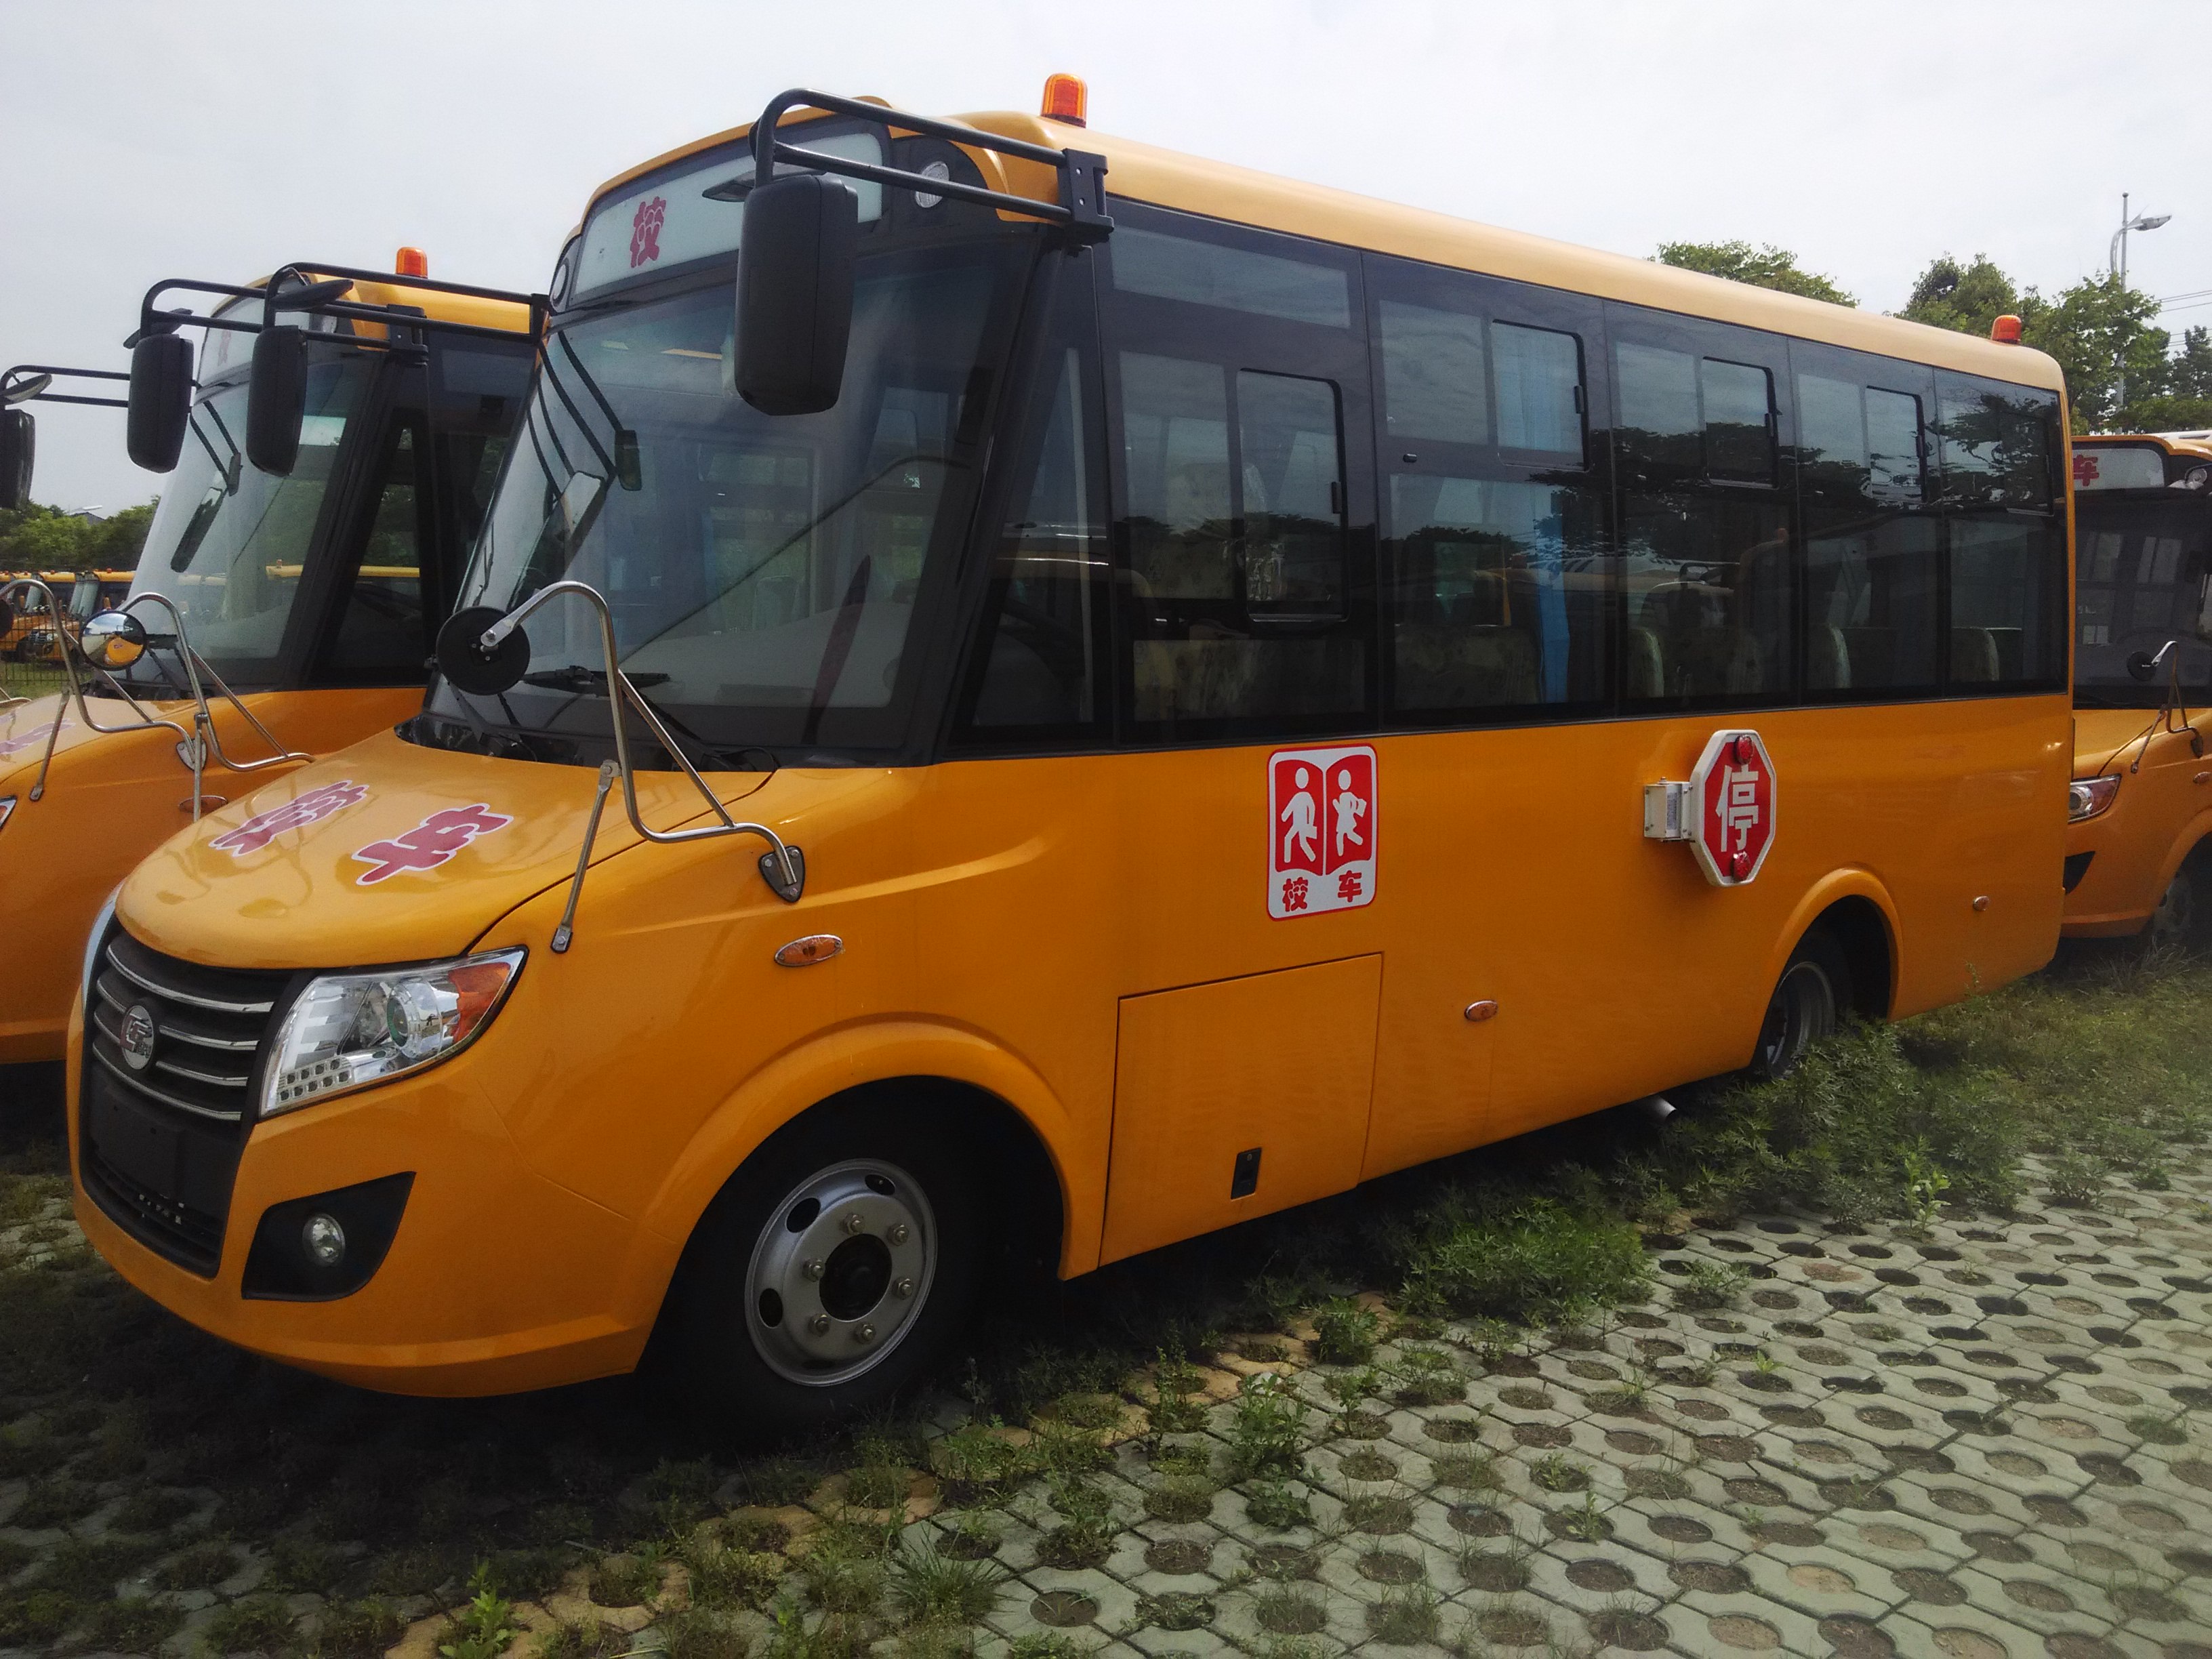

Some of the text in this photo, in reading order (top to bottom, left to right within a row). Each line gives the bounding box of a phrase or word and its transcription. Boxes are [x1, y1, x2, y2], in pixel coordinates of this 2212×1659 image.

[630, 196, 667, 268] 校
[208, 780, 514, 886] 校车
[1715, 763, 1759, 853] 停
[1282, 869, 1363, 912] 校车
